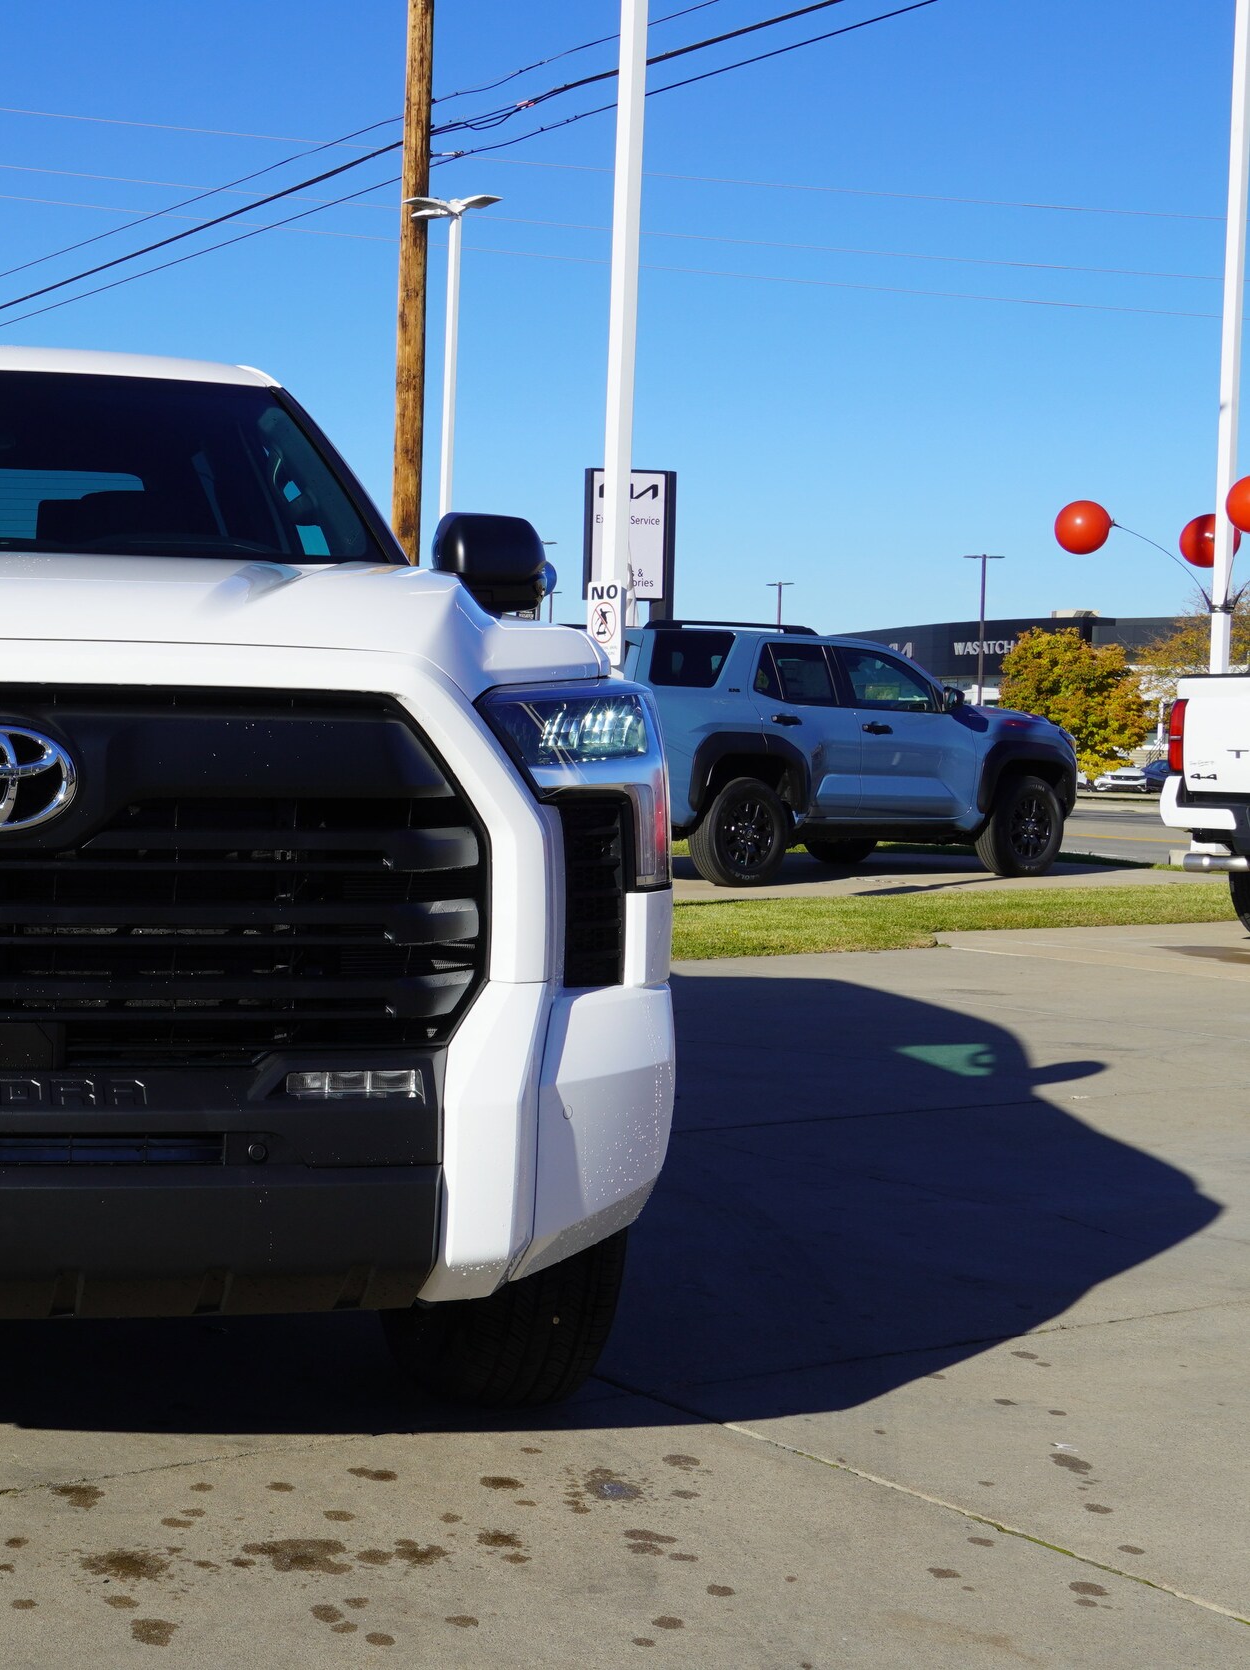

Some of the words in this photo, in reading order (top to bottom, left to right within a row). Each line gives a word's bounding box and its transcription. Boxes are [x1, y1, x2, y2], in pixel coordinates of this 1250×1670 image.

[630, 515, 660, 526] Service
[591, 584, 618, 600] NO
[953, 640, 1014, 655] WASATCH
